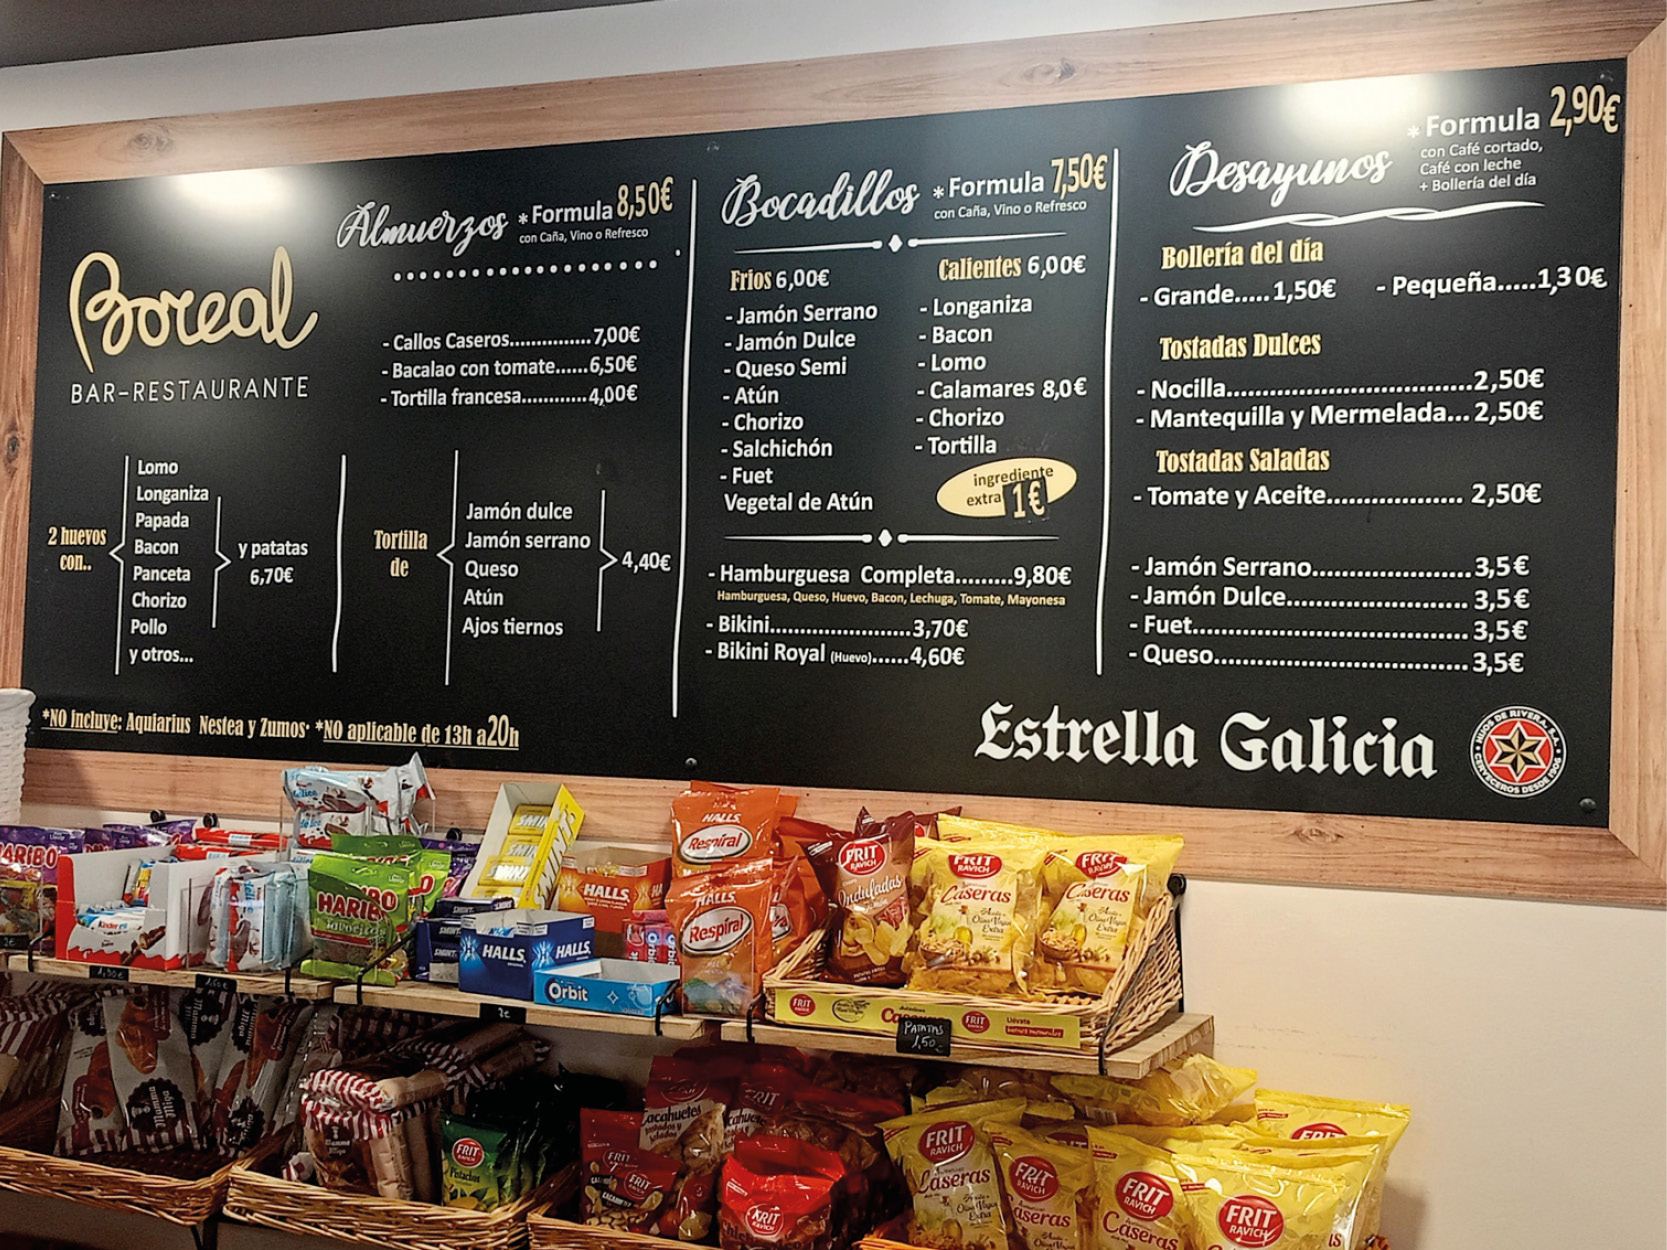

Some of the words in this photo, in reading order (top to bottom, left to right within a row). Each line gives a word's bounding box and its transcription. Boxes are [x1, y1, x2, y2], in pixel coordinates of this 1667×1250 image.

[1549, 84, 1621, 137] 2,90€
[1420, 146, 1446, 159] con
[1449, 141, 1481, 157] Café
[1483, 138, 1544, 157] cortado,
[1168, 140, 1394, 208] Desayunos
[1420, 160, 1451, 175] Café
[1454, 162, 1480, 174] con
[1483, 156, 1522, 172] leche
[1050, 152, 1109, 201] 7,50€
[1432, 175, 1485, 192] Bollería
[1488, 173, 1511, 189] del
[1513, 171, 1537, 187] día
[616, 176, 674, 221] 8,50€
[721, 168, 921, 228] Bocadillos
[933, 207, 956, 220] con
[957, 204, 991, 219] Caña,
[993, 203, 1022, 216] Vino
[1034, 199, 1088, 214] Refresco
[336, 201, 510, 258] Almuerzos
[518, 233, 538, 245] con
[539, 230, 568, 244] Caña,
[569, 229, 594, 242] Vino
[604, 226, 649, 240] Refresco
[1160, 241, 1245, 270] Bollería
[1249, 239, 1284, 266] del
[1289, 236, 1324, 263] día
[938, 255, 1022, 282] Calientes
[1027, 254, 1087, 280] 6,00€
[729, 268, 773, 292] Frios
[775, 268, 830, 292] 6,00€
[69, 246, 320, 373] Boreal
[735, 303, 799, 325] Jamón
[802, 303, 878, 323] Serrano
[932, 294, 1034, 322] Longaniza
[393, 332, 442, 352] Callos
[734, 330, 798, 352] Jamón
[802, 328, 857, 350] Dulce
[931, 325, 993, 344] Bacon
[1159, 334, 1248, 361] Tostadas
[1251, 331, 1322, 358] Dulces
[392, 359, 456, 379] Bacalao
[459, 362, 490, 377] con
[735, 359, 796, 381] Queso
[799, 355, 848, 377] Semi
[930, 353, 987, 372] Lomo
[390, 387, 447, 407] Tortilla
[733, 384, 780, 405] Atún
[929, 378, 1036, 400] Calamares
[1041, 376, 1088, 402] 8,0€
[733, 411, 804, 432] Chorizo
[928, 406, 1005, 428] Chorizo
[1150, 404, 1285, 432] Mantequilla
[732, 437, 833, 459] Salchichón
[926, 433, 998, 455] Tortilla
[137, 459, 179, 476] Lomo
[1155, 448, 1245, 474] Tostadas
[1248, 446, 1331, 472] Saladas
[732, 466, 774, 485] Fuet
[973, 465, 1054, 487] ingrediente
[136, 484, 210, 506] Longaniza
[723, 491, 794, 516] Vegetal
[825, 490, 874, 511] Atún
[967, 492, 1001, 507] extra
[1013, 482, 1046, 518] 1€
[1146, 485, 1230, 506] Tomate
[1470, 481, 1542, 508] 2,50€
[134, 510, 190, 532] Papada
[465, 501, 522, 521] Jamón
[526, 501, 573, 520] dulce
[47, 526, 58, 546] 2
[59, 525, 107, 546] huevos
[373, 529, 429, 551] Tortilla
[464, 529, 521, 549] Jamón
[524, 534, 592, 549] serrano
[133, 538, 179, 555] Bacon
[250, 540, 309, 560] patatas
[464, 559, 519, 580] Queso
[621, 550, 672, 574] 4,40€
[1143, 554, 1218, 577] Jamón
[132, 565, 192, 582] Panceta
[249, 566, 295, 586] 6,70€
[720, 563, 850, 588] Hamburguesa
[131, 590, 188, 609] Chorizo
[462, 587, 504, 606] Atún
[716, 589, 791, 604] Hamburguesa,
[792, 590, 830, 604] Queso,
[831, 591, 869, 605] Huevo,
[870, 591, 908, 606] Bacon,
[909, 591, 958, 607] Lechuga,
[959, 592, 1005, 607] Tomate,
[1006, 593, 1066, 608] Mayonesa
[1142, 584, 1217, 606] Jamón
[130, 617, 168, 636] Pollo
[461, 616, 500, 639] Ajos
[502, 616, 564, 636] tiernos
[717, 640, 770, 661] Bikini
[773, 642, 826, 666] Royal
[70, 709, 122, 733] incluye:
[126, 712, 191, 735] Aquiarius
[199, 715, 244, 736] Nestea
[347, 721, 417, 742] aplicable
[445, 725, 472, 746] 13h
[1475, 719, 1494, 743] HIJOS
[1494, 712, 1507, 721] DE
[973, 700, 1199, 769] Estrella
[1219, 711, 1438, 780] Galicia
[1475, 754, 1520, 793] CERVECEROS
[1522, 776, 1550, 793] DESDE
[1548, 757, 1562, 777] 1906
[702, 813, 741, 823] HALLS
[688, 832, 743, 851] Respiral
[845, 845, 879, 863] FRIT
[954, 855, 996, 867] FRIT
[850, 860, 876, 871] RAVICH
[957, 864, 990, 873] RAVICH
[583, 884, 630, 902] HALLS
[694, 892, 737, 906] HALLS
[838, 876, 902, 907] Onduladas
[940, 884, 1012, 904] Caseras
[1066, 883, 1130, 903] Caseras
[689, 913, 744, 944] Respiral
[482, 944, 526, 962] HALLS
[556, 940, 591, 956] HALLS
[549, 982, 588, 1001] Orbit
[793, 998, 812, 1008] FRIT
[904, 1020, 944, 1036] PATATAS
[964, 1013, 986, 1024] FRIT
[641, 1106, 702, 1126] Cacahuetes
[926, 1125, 966, 1148] FRIT
[457, 1143, 479, 1156] FRIT
[930, 1143, 963, 1156] RAVICH
[450, 1165, 480, 1183] Pistachos
[628, 1173, 652, 1190] FRIT
[917, 1168, 991, 1193] Caseras
[1015, 1161, 1053, 1188] FRIT
[1017, 1181, 1046, 1195] RAVICH
[1123, 1177, 1170, 1205] FRIT
[1124, 1197, 1156, 1214] RAVICH
[1226, 1204, 1278, 1228] FRIT
[1103, 1210, 1178, 1250] Caseras
[1229, 1224, 1269, 1239] RAVICH
